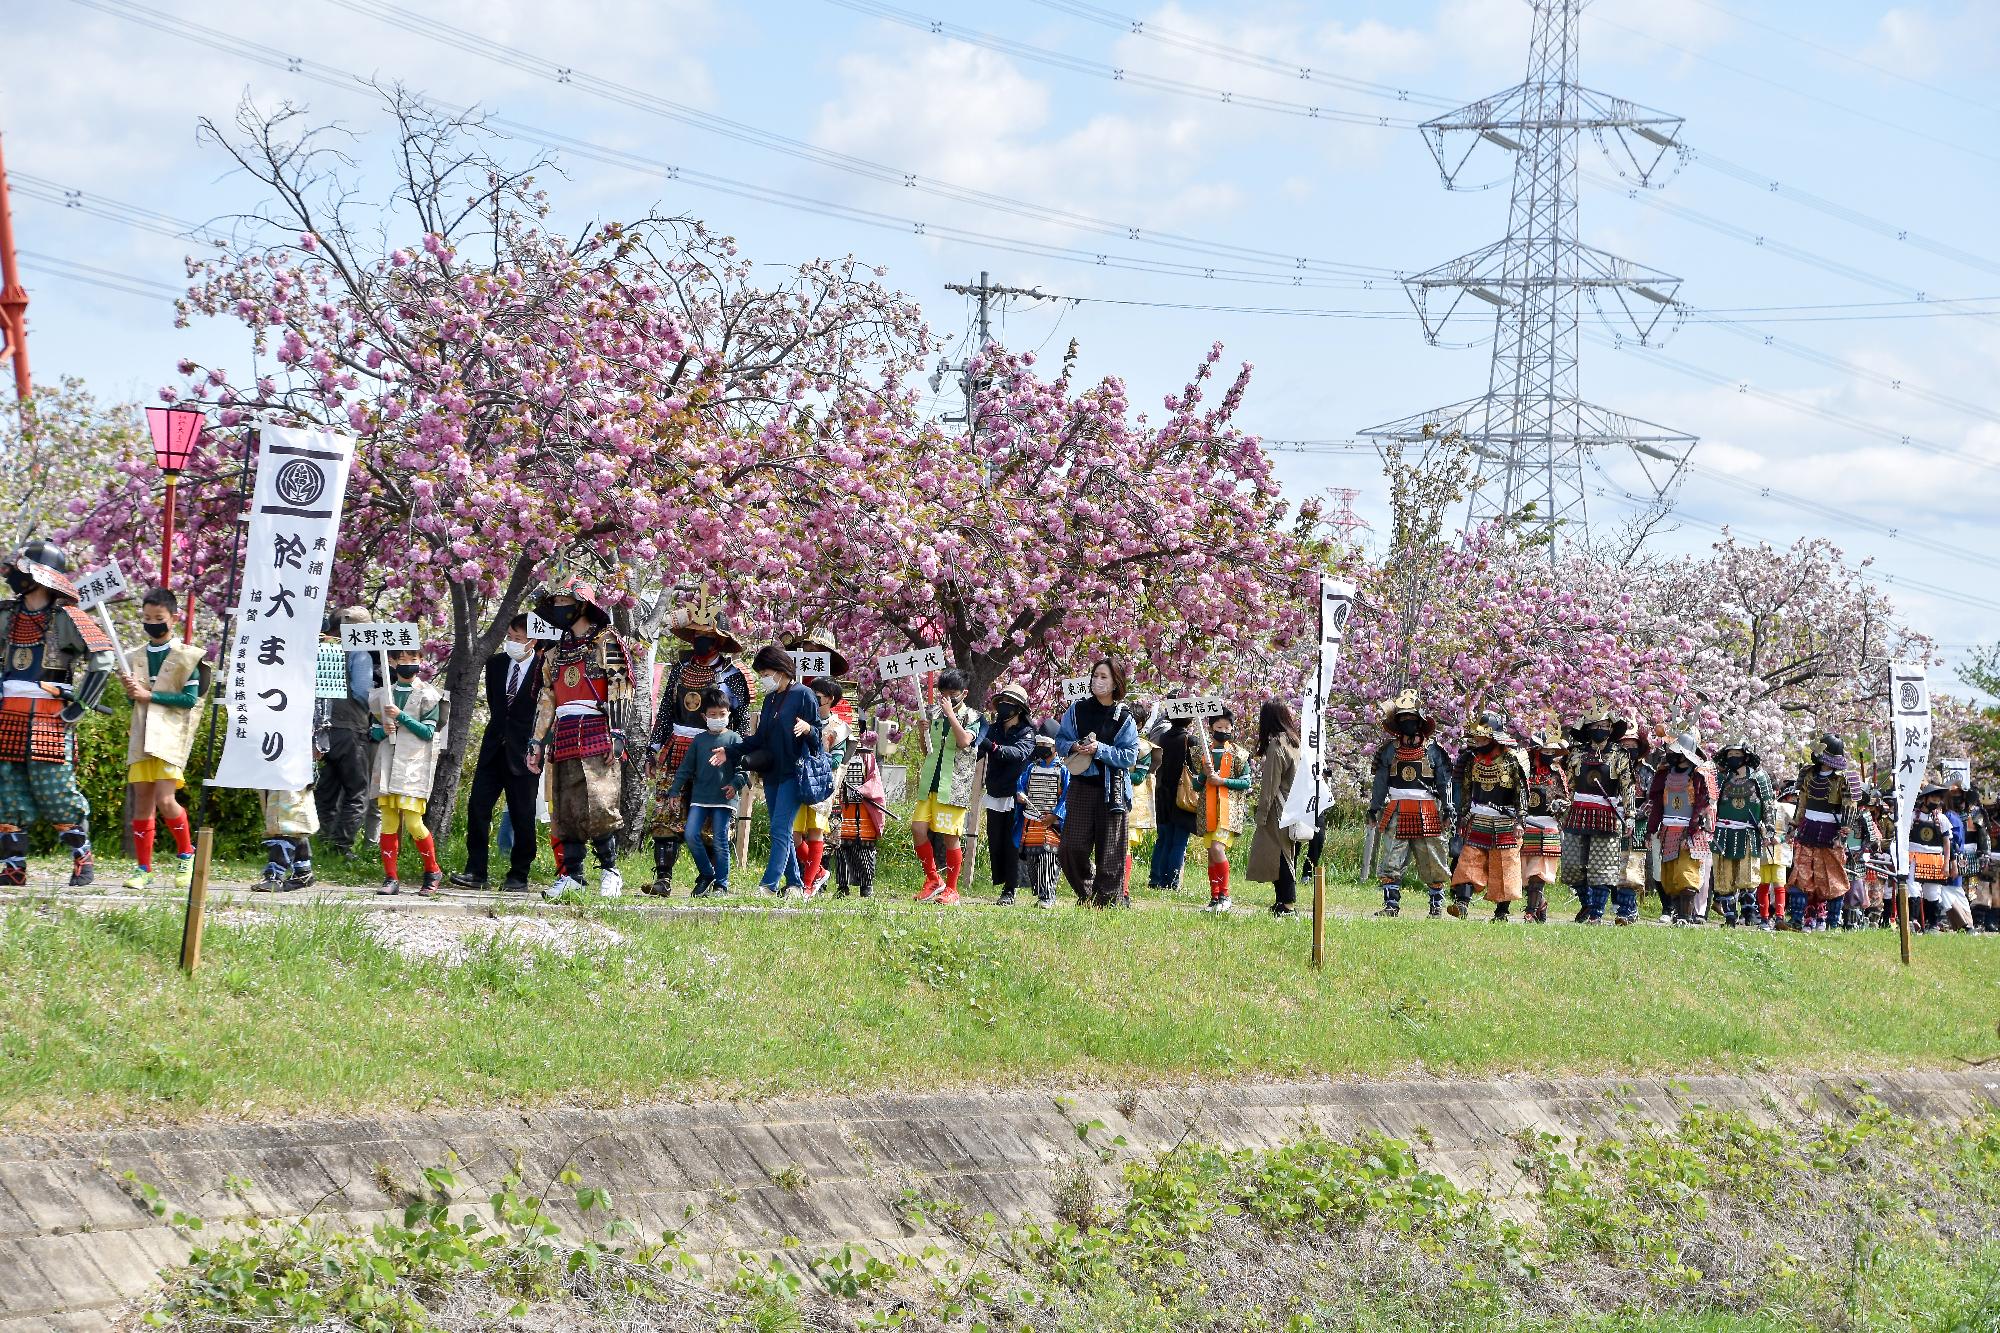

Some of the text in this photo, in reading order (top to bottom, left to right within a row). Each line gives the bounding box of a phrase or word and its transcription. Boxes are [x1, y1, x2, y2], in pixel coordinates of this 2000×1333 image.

[304, 536, 328, 600] 東浦町
[246, 588, 262, 622] 協賛
[257, 533, 307, 762] 於大まつり
[348, 627, 413, 647] 水野忠善
[885, 652, 939, 675] 竹千代
[1171, 700, 1219, 715] 水野信元
[936, 811, 953, 830] 55
